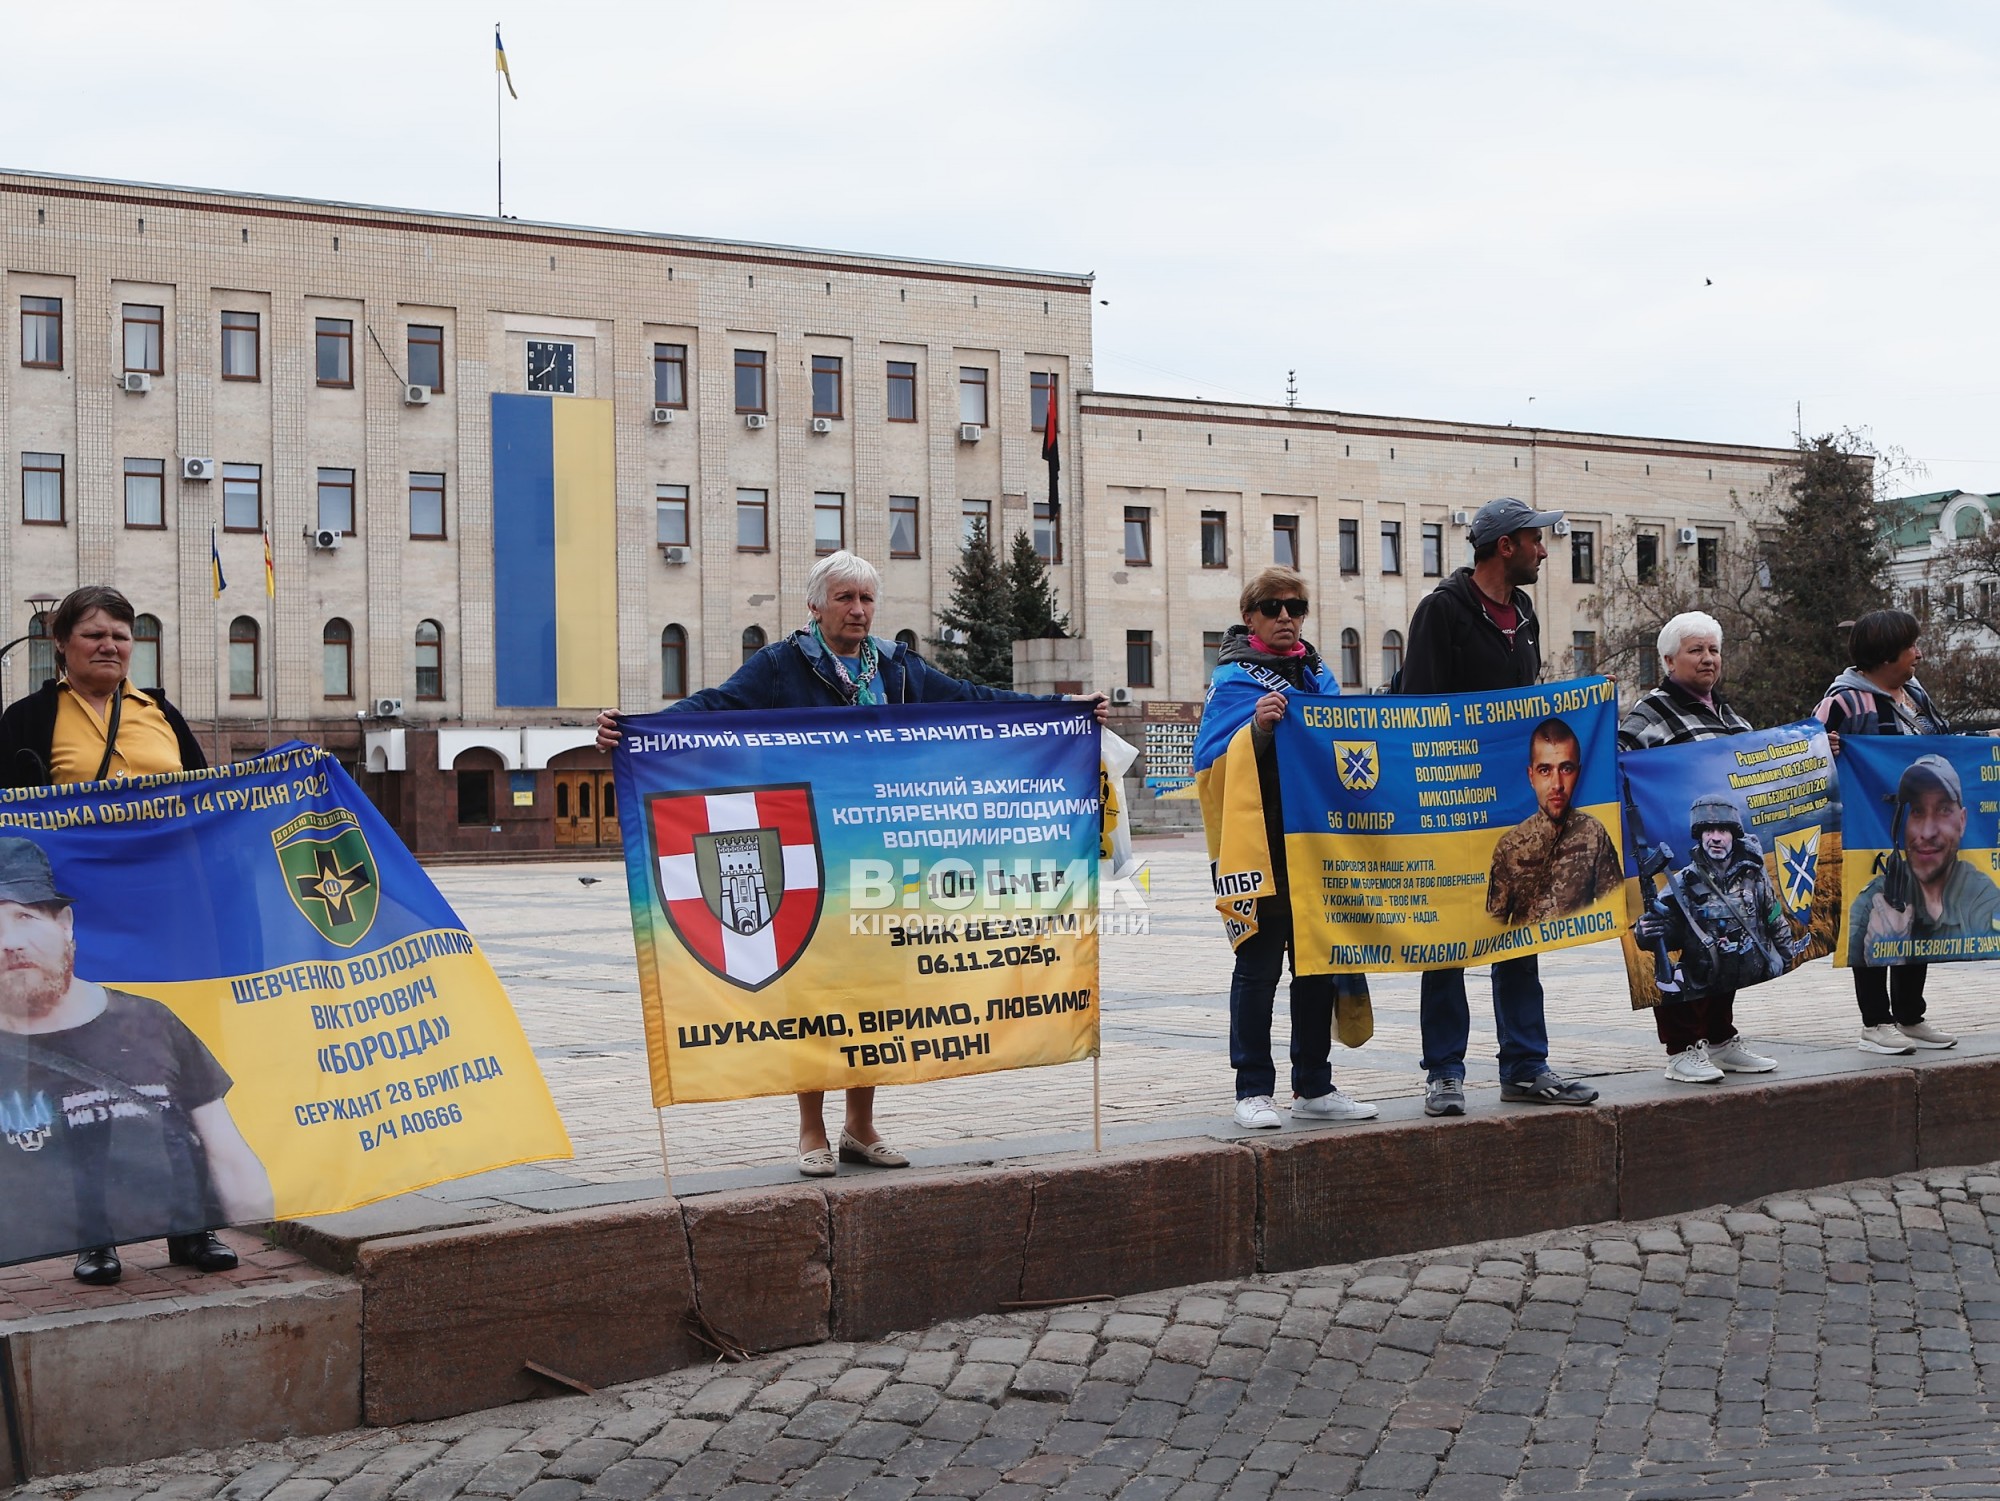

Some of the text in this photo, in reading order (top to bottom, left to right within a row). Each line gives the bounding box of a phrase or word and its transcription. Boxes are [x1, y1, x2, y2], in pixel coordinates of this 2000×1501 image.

[1303, 705, 1379, 729] БЕЗВІСТИ
[1380, 702, 1452, 729] ЗНИКЛИЙ
[1463, 703, 1484, 725] НЕ
[1486, 695, 1551, 724] ЗНАЧИТЬ
[628, 730, 741, 753] ЗНИКЛИЙ
[743, 731, 849, 746] БЕЗВІСТИ
[865, 729, 895, 743] НЕ
[897, 725, 994, 742] ЗНАЧИТЬ
[997, 715, 1092, 739] ЗАБУТИЙ!
[1412, 739, 1479, 758] ШУЛЯРЕНКО
[1415, 763, 1482, 782] ВОЛОДИМИР
[873, 776, 1066, 799] ЗНИКЛИЙ ЗАХИСНИК
[1418, 786, 1497, 807] МИКОЛАЙОВИЧ
[0, 805, 97, 831] ОНЕЦЬКА
[99, 795, 187, 823] ОБЛАСТЬ
[193, 792, 215, 814] 14
[216, 784, 290, 812] ГРУДНЯ
[832, 802, 979, 825] КОТЛЯРЕНКО
[983, 798, 1099, 821] ВОЛОДИМИР
[1327, 811, 1395, 830] 56 ОМПБР
[276, 817, 307, 841] ВОЛЕЮ
[883, 823, 1071, 849] ВОЛОДИМИРОВИЧ
[1322, 859, 1436, 872] ТИ БОРОВСЯ ЗА НАШЕ ЖИТТЯ.
[1322, 877, 1349, 889] ТЕПЕР
[1403, 878, 1414, 888] ЗА
[1416, 877, 1436, 888] ТВОЄ
[1436, 872, 1487, 888] ПОВЕРНЕННЯ.
[1323, 895, 1329, 905] У
[1330, 894, 1364, 906] КОЖНІЙ
[1389, 895, 1409, 906] ТВОЄ
[1324, 912, 1330, 923] У
[1331, 912, 1374, 923] КОЖНОМУ
[1376, 912, 1406, 924] ПОДИХУ
[1413, 911, 1440, 923] НАДІЯ.
[890, 924, 959, 946] ЗНИК
[1329, 911, 1617, 965] ЛЮБИМО. ЧЕКАЄМО. ШУКАЄМО. БОРЕМОСЯ.
[1914, 938, 1962, 956] БЕЗВІСТИ
[1963, 937, 1976, 953] НЕ
[1977, 935, 2000, 952] ЗНАЧ
[231, 932, 473, 1005] ШЕВЧЕНКО ВОЛОДИМИР
[917, 944, 1061, 975] 06.11.2025р.
[310, 975, 438, 1030] ВІКТОРОВИЧ
[678, 988, 1091, 1049] ШУКАЄМО, ВІРИМО, ЛЮБИМО!
[318, 1015, 451, 1074] «БОРОДА»
[840, 1032, 991, 1068] ТВОЇ РІДНІ
[294, 1056, 503, 1127] СЕРЖАНТ 28 БРИГАДА
[358, 1119, 398, 1151] В/Ч
